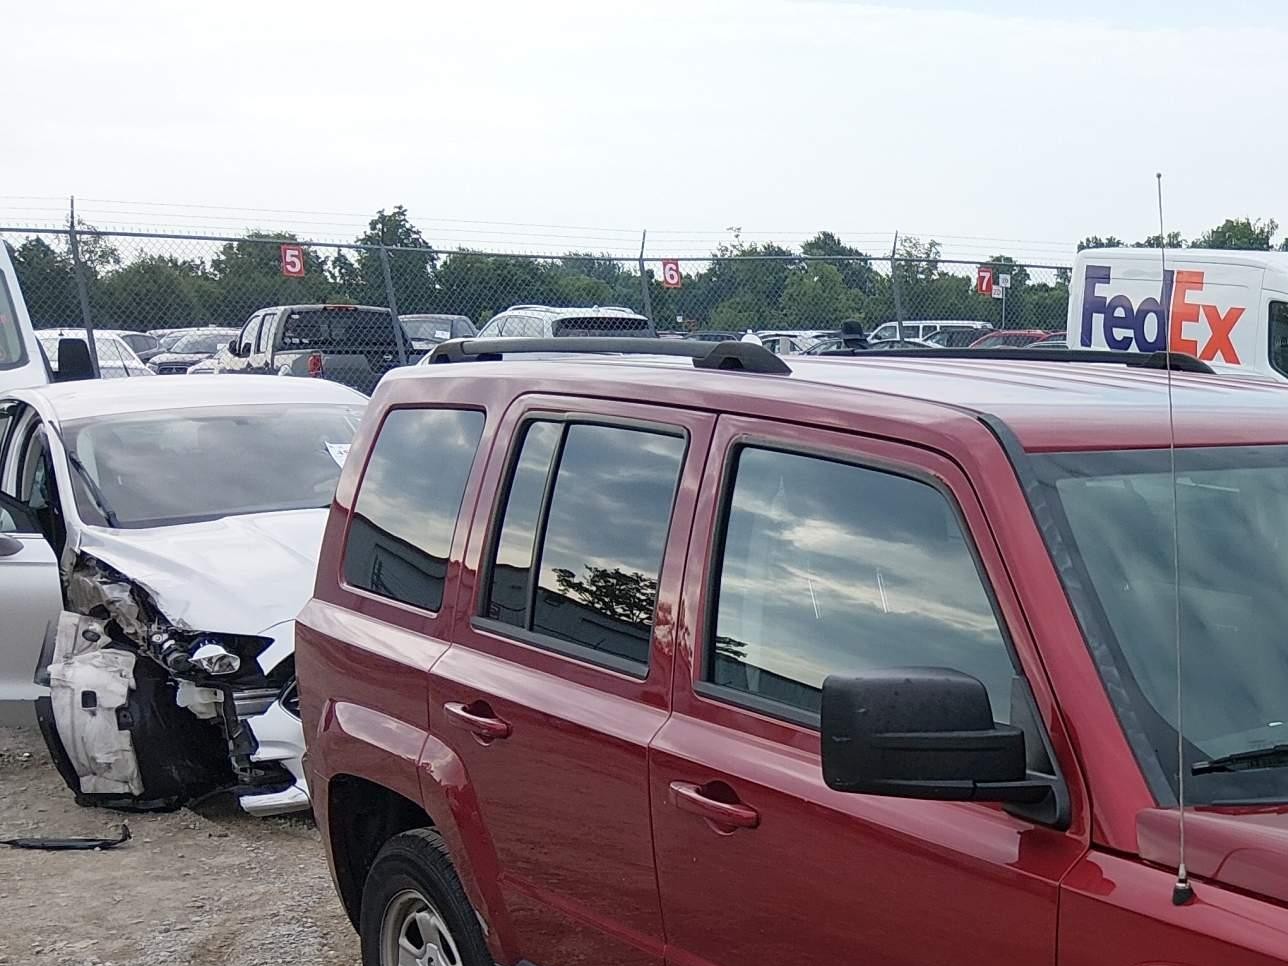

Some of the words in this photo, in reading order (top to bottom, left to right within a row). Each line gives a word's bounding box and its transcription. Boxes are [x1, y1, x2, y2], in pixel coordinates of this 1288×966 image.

[285, 249, 301, 273] 5
[664, 263, 679, 285] 6
[979, 271, 991, 291] 7
[1080, 264, 1246, 365] FedEx
